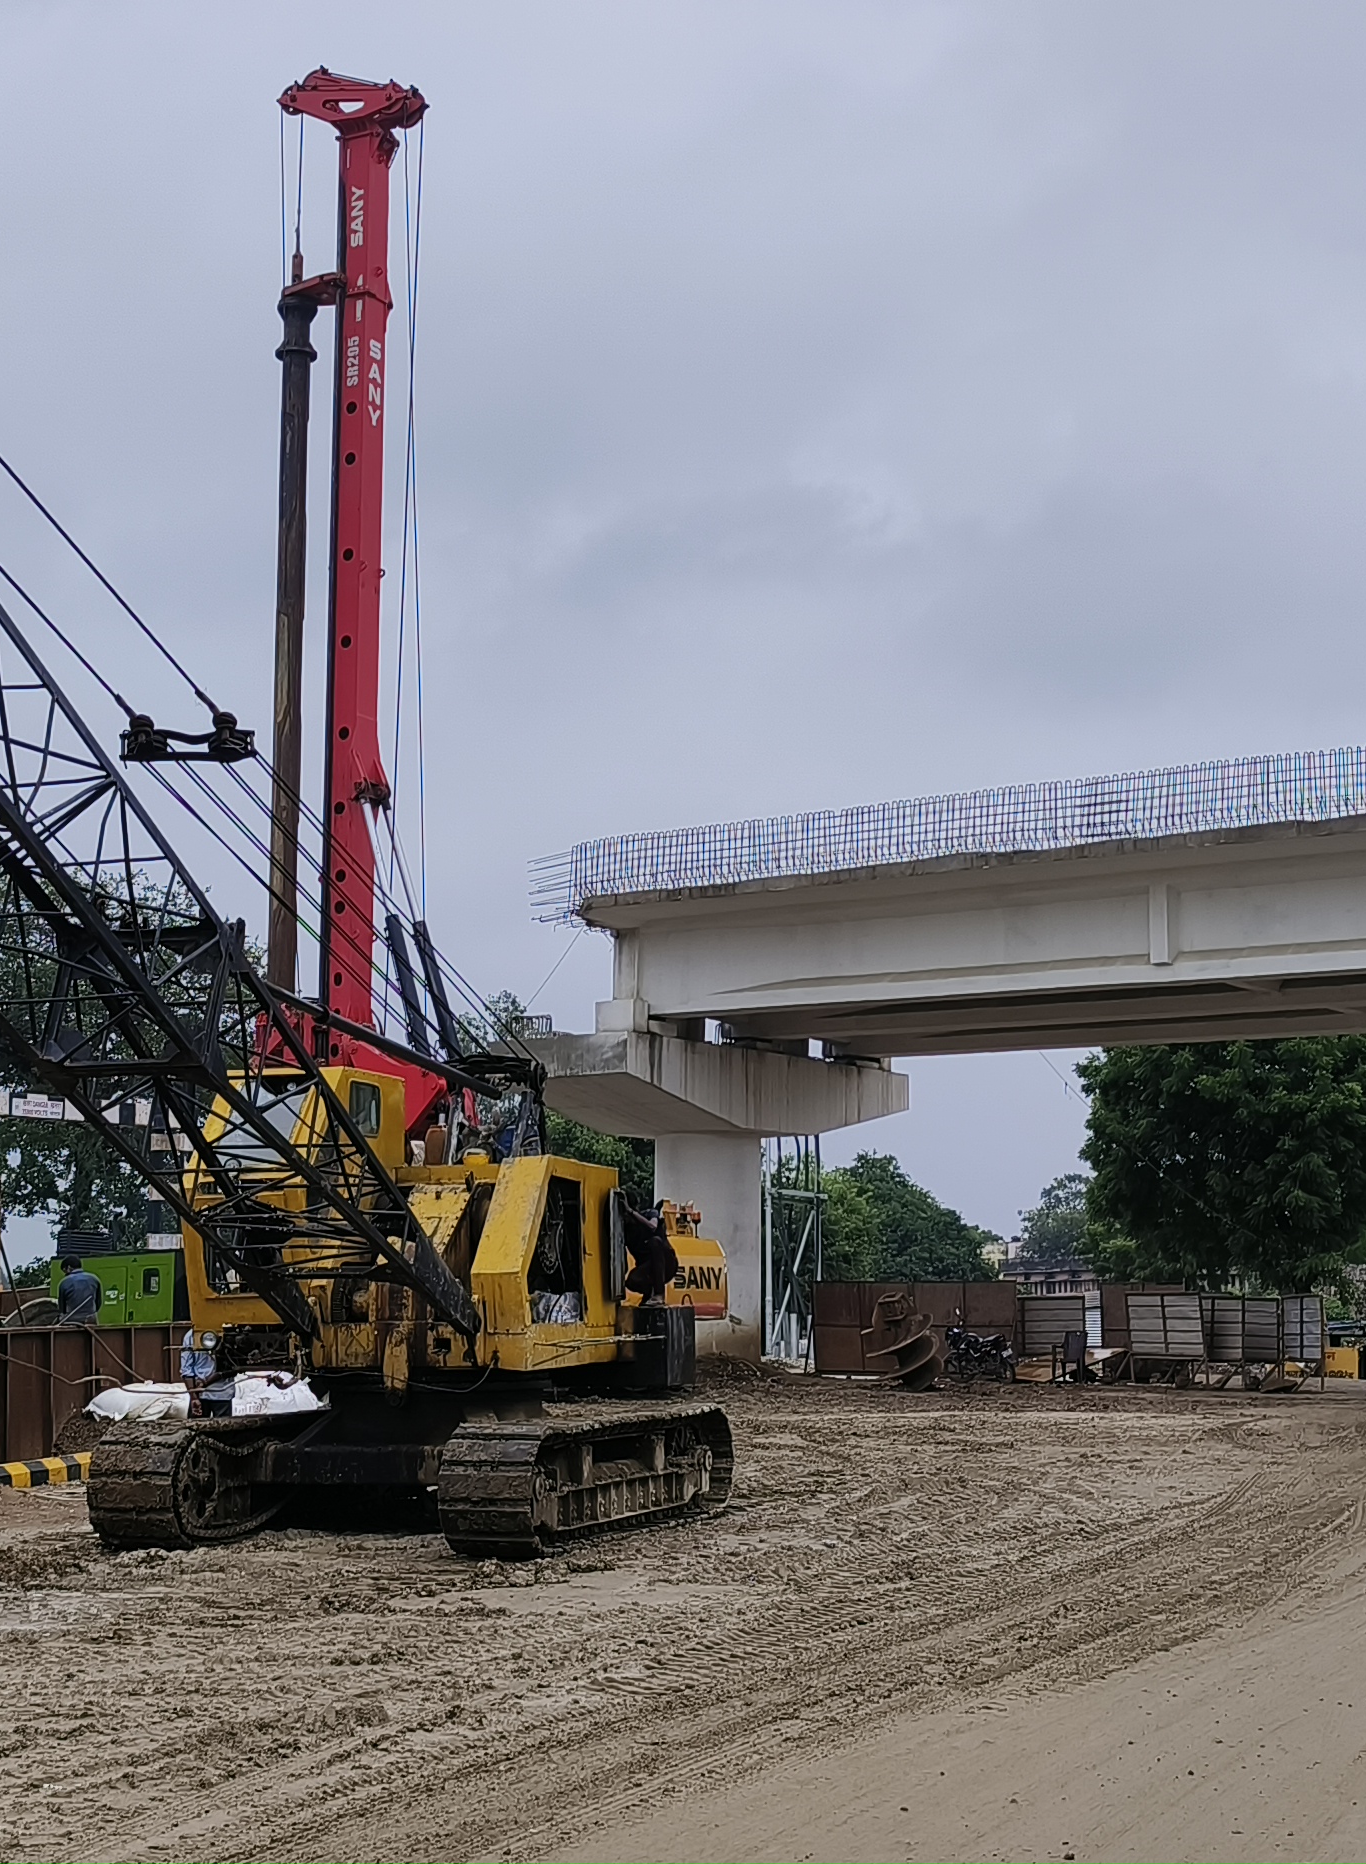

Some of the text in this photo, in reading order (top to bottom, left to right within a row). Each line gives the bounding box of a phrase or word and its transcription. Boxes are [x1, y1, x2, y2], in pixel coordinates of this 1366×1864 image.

[350, 186, 364, 248] SANY
[346, 335, 359, 387] SR205
[368, 339, 382, 427] SANY
[673, 1265, 722, 1290] SANY
